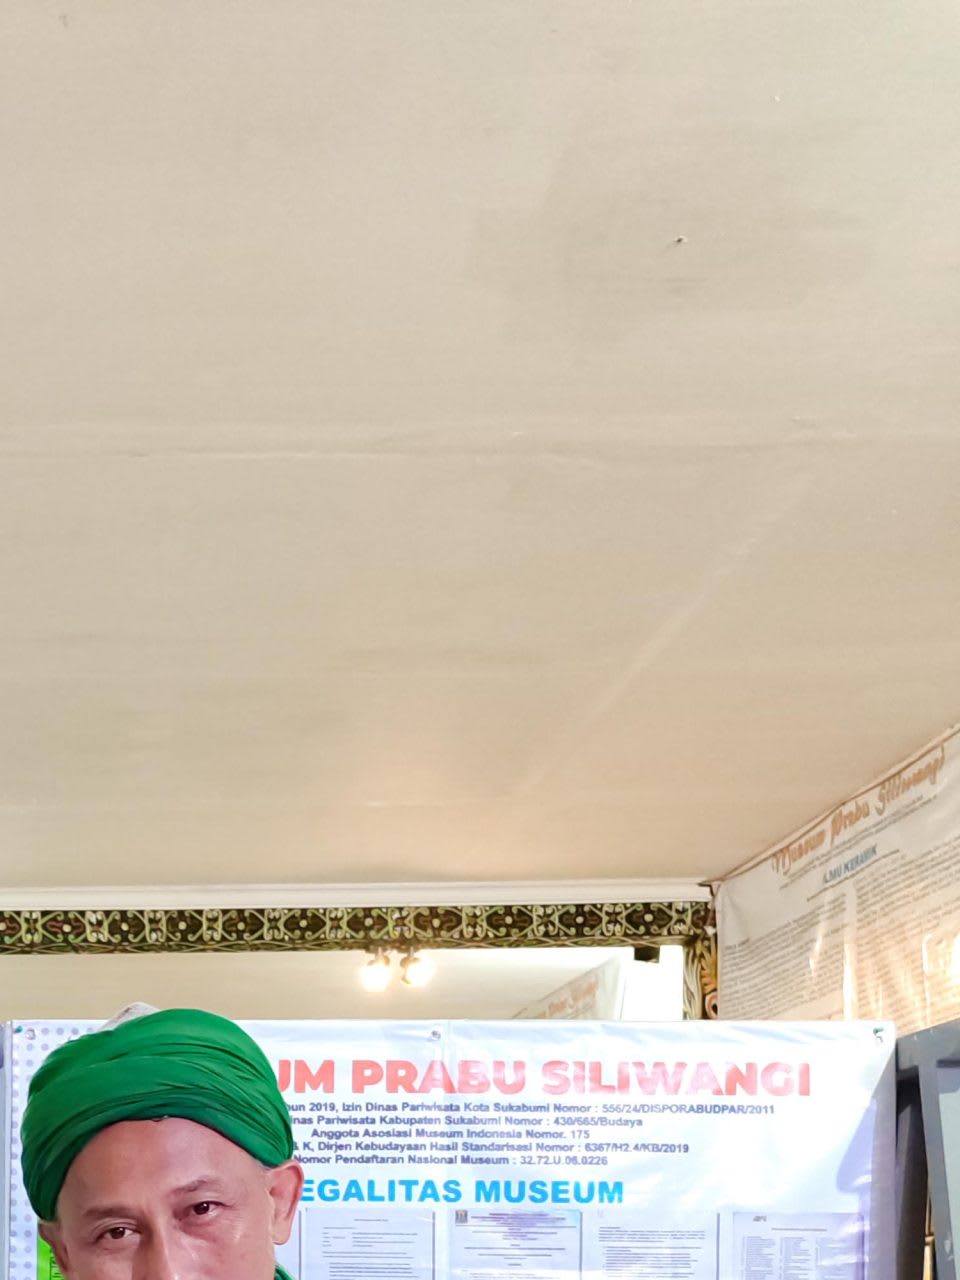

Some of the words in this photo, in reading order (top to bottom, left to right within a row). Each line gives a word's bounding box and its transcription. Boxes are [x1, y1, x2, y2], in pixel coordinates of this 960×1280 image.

[352, 1060, 526, 1095] PRABU
[541, 1060, 811, 1097] SILIWANGI
[309, 1102, 338, 1113] 2019,
[342, 1102, 363, 1112] Izin
[365, 1102, 398, 1112] Dinas
[401, 1102, 461, 1112] Pariwisata
[464, 1102, 490, 1112] Kota
[493, 1103, 550, 1113] Sukabumi
[553, 1103, 591, 1113] Nomor
[317, 1115, 376, 1125] Pariwisata
[380, 1115, 441, 1127] Kabupaten
[444, 1115, 501, 1126] Sukabumi
[505, 1116, 543, 1126] Nomor
[311, 1128, 360, 1140] Anggota
[362, 1128, 412, 1138] Asosiasi
[415, 1129, 464, 1138] Museum
[467, 1129, 522, 1139] Indonesia
[571, 1130, 590, 1139] 175
[303, 1141, 315, 1152] K,
[318, 1141, 352, 1153] Dirjen
[355, 1141, 426, 1153] Kebudayaan
[430, 1142, 458, 1151] Hasil
[462, 1142, 532, 1152] Standarisasi
[536, 1143, 574, 1152] Nomor
[294, 1154, 332, 1164] Nomor
[335, 1154, 404, 1164] Pendaftaran
[408, 1155, 457, 1164] Nasional
[461, 1155, 509, 1165] Museum
[301, 1179, 462, 1203] EGALITAS
[474, 1180, 623, 1203] MUSEUM
